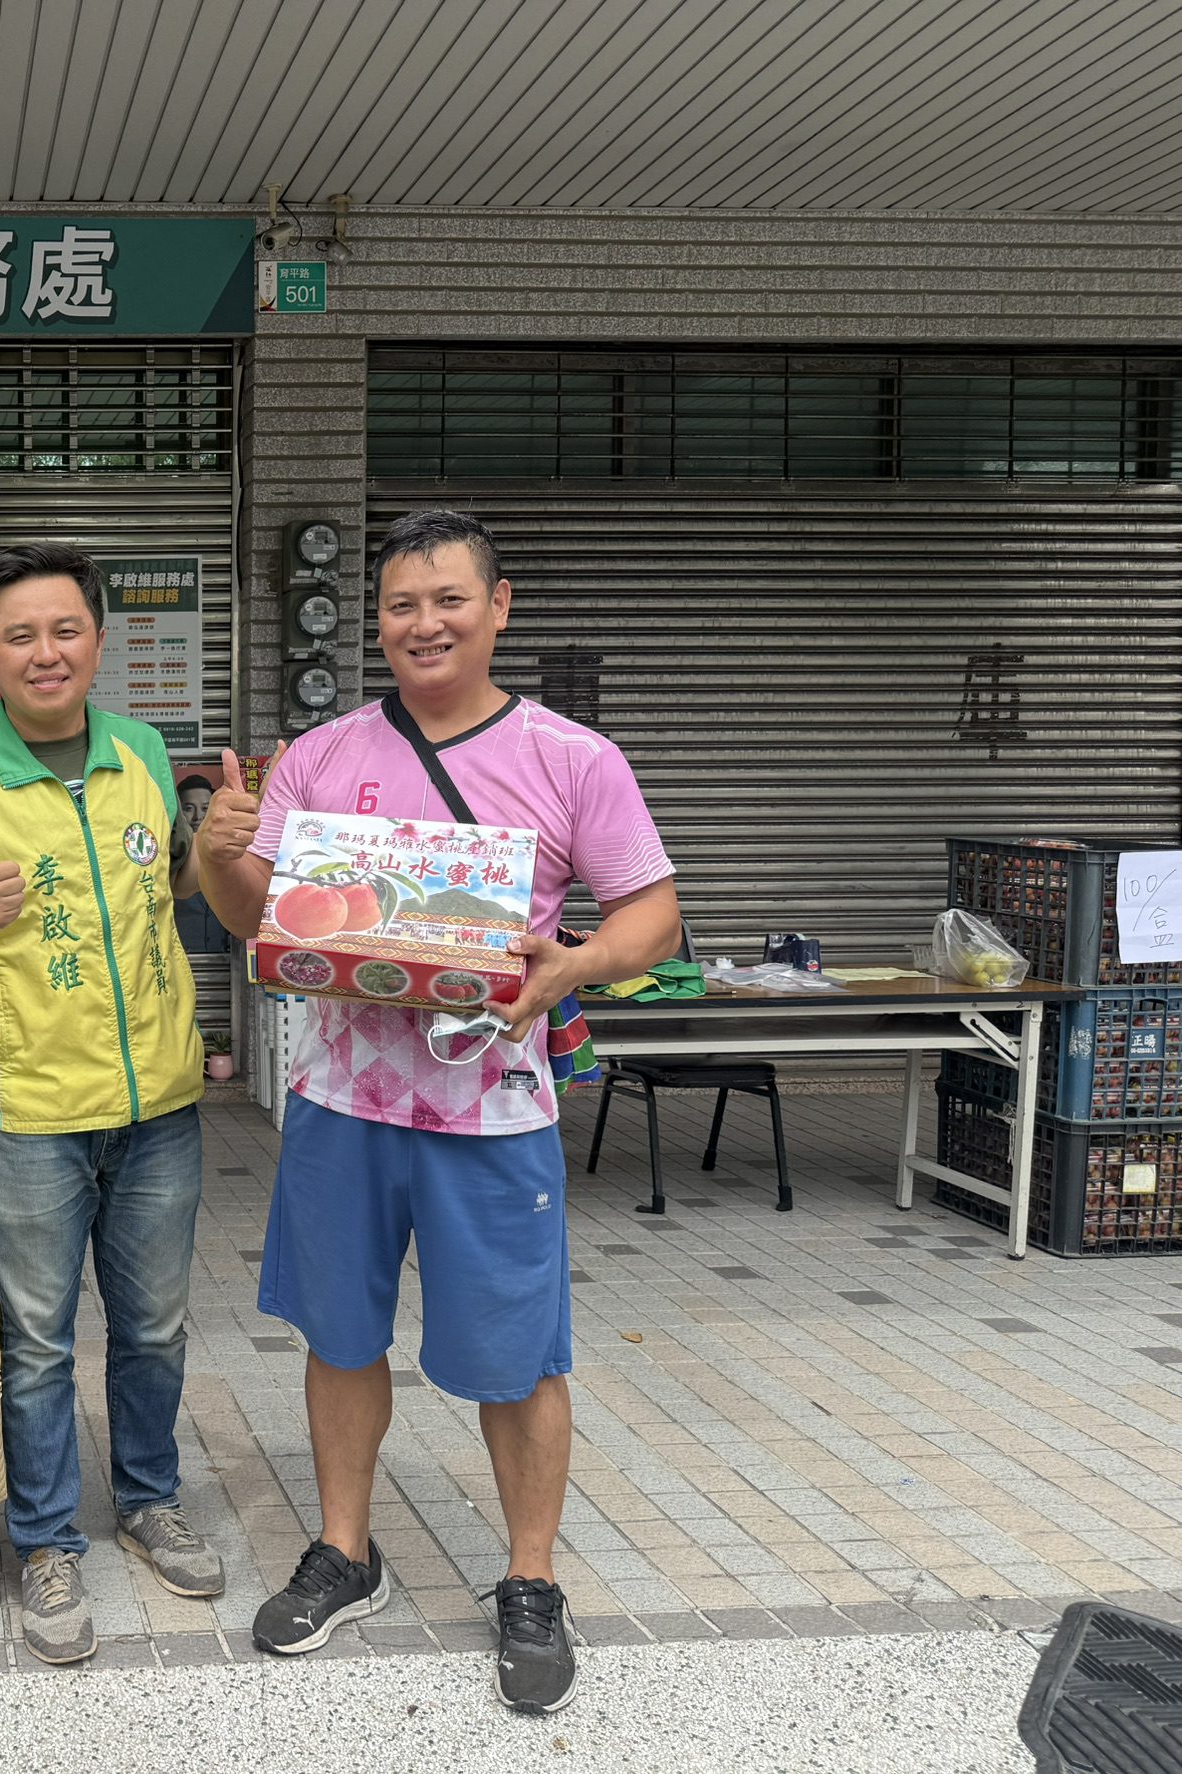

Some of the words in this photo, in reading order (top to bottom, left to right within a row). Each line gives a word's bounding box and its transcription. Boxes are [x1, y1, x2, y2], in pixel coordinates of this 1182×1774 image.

[279, 267, 310, 279] 育平路
[285, 285, 316, 303] 501
[109, 572, 195, 588] 李啟維服務處
[122, 588, 179, 604] 諮詢服務
[355, 782, 380, 814] 6
[350, 850, 514, 887] 高山水蜜桃
[32, 854, 83, 991] 李啟維
[139, 870, 168, 996] 台南市議員
